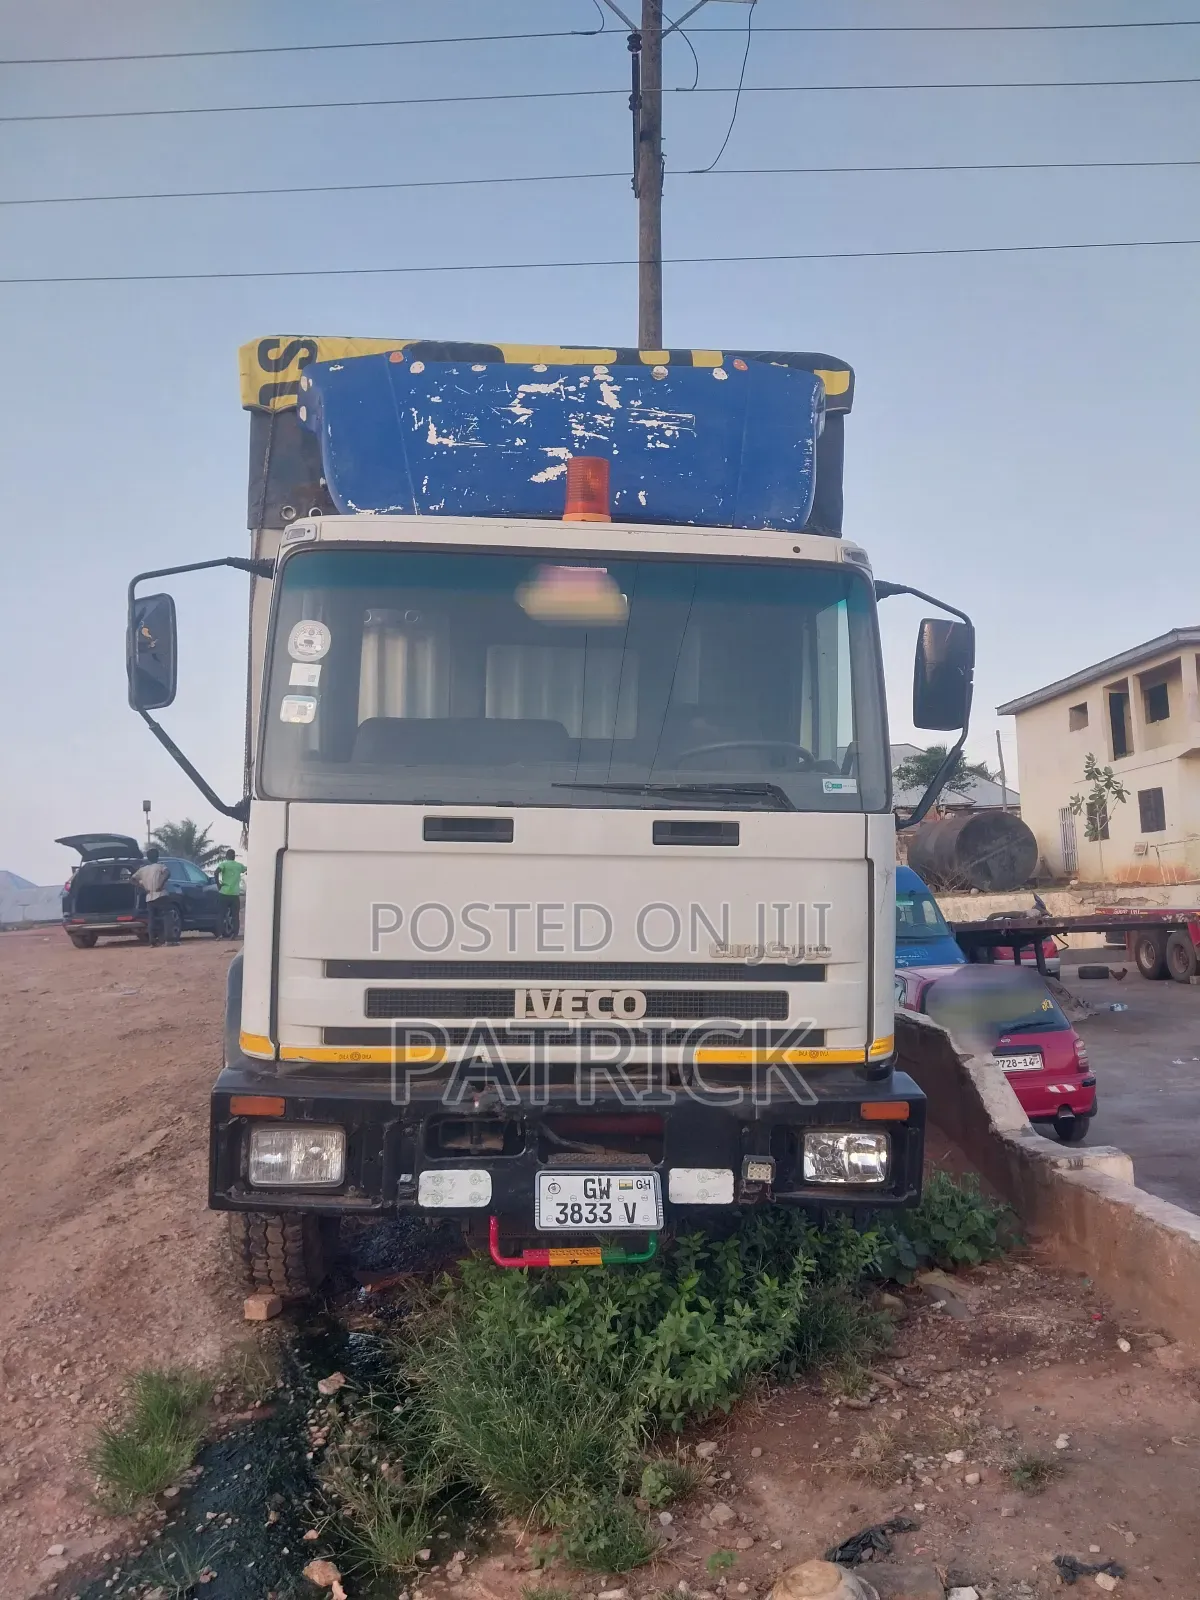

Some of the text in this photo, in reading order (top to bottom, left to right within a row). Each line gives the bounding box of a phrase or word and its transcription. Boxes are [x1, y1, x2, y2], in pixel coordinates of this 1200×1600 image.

[515, 989, 647, 1020] IVECO
[583, 1178, 611, 1200] GW
[555, 1202, 637, 1225] 3833 V
